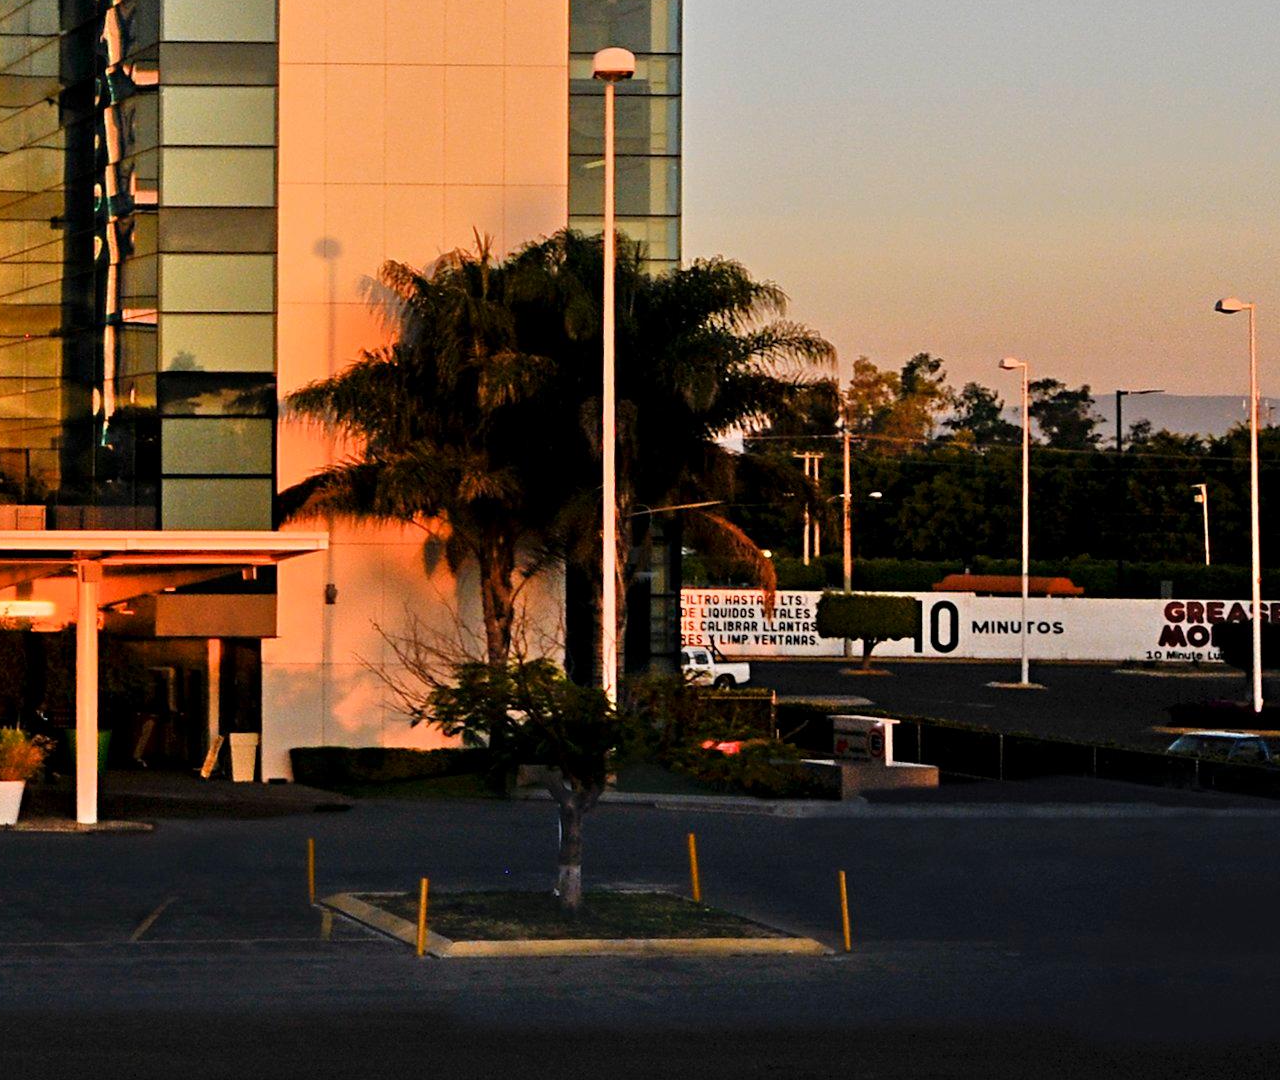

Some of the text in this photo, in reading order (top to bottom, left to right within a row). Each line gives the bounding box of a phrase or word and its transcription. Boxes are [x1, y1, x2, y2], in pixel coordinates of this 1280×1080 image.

[681, 594, 720, 605] FILTRO
[725, 595, 764, 605] HASTA
[681, 607, 811, 619] DE LIQUIDOS VTALES
[700, 621, 758, 632] CALIBRAR
[763, 621, 817, 632] LLANTAS
[972, 621, 1064, 634] MINUTOS
[1146, 651, 1162, 660] 10
[1167, 651, 1203, 660] Minute
